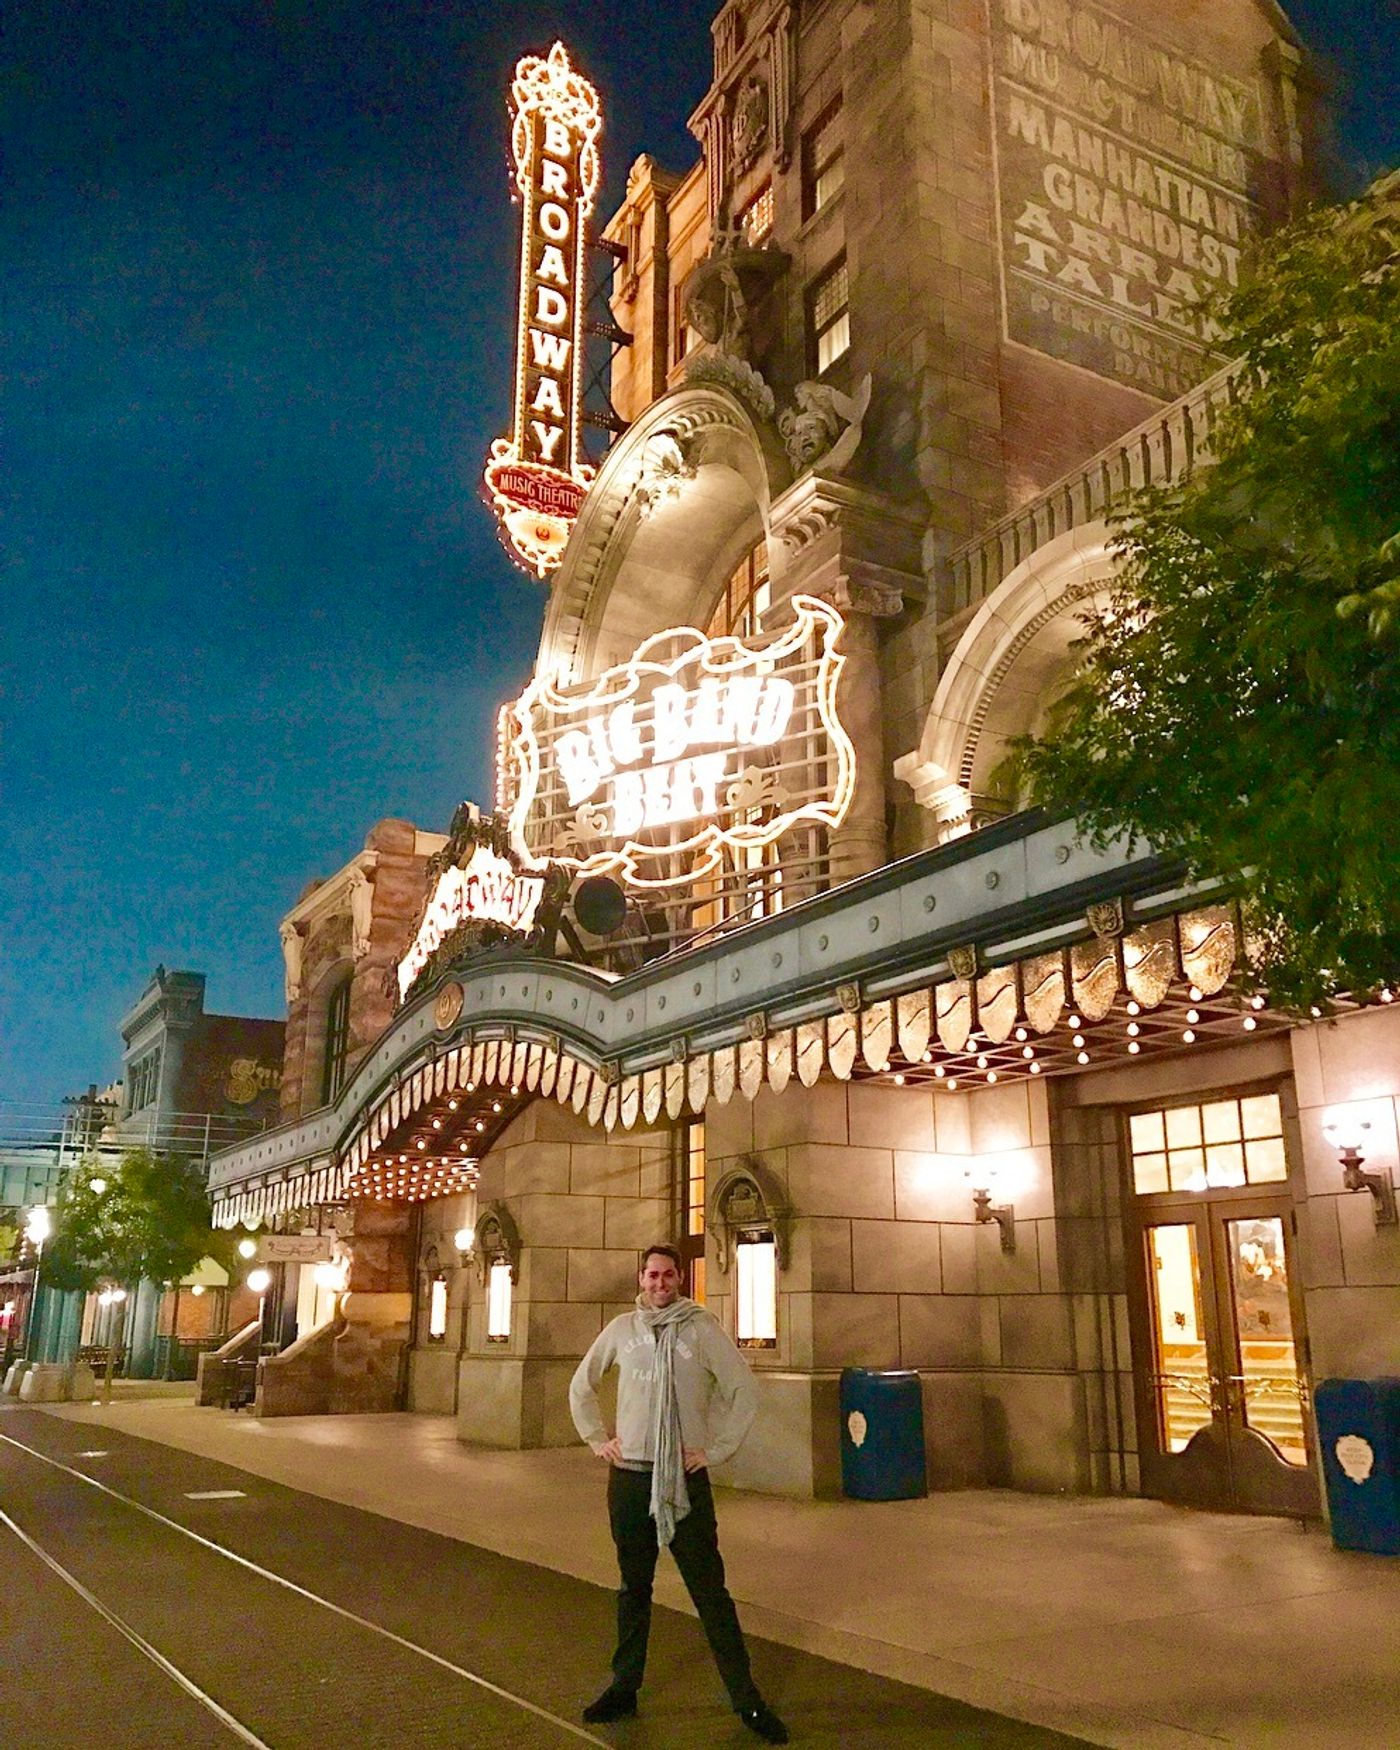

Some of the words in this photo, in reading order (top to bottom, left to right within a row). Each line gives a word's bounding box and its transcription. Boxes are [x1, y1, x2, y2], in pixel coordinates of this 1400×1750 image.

[1008, 32, 1115, 121] MUIC
[1043, 163, 1240, 288] GRANDEST
[528, 117, 572, 462] BROADWAY
[499, 473, 536, 498] MUSIC
[553, 700, 643, 807] BIG
[652, 677, 795, 763] BAND
